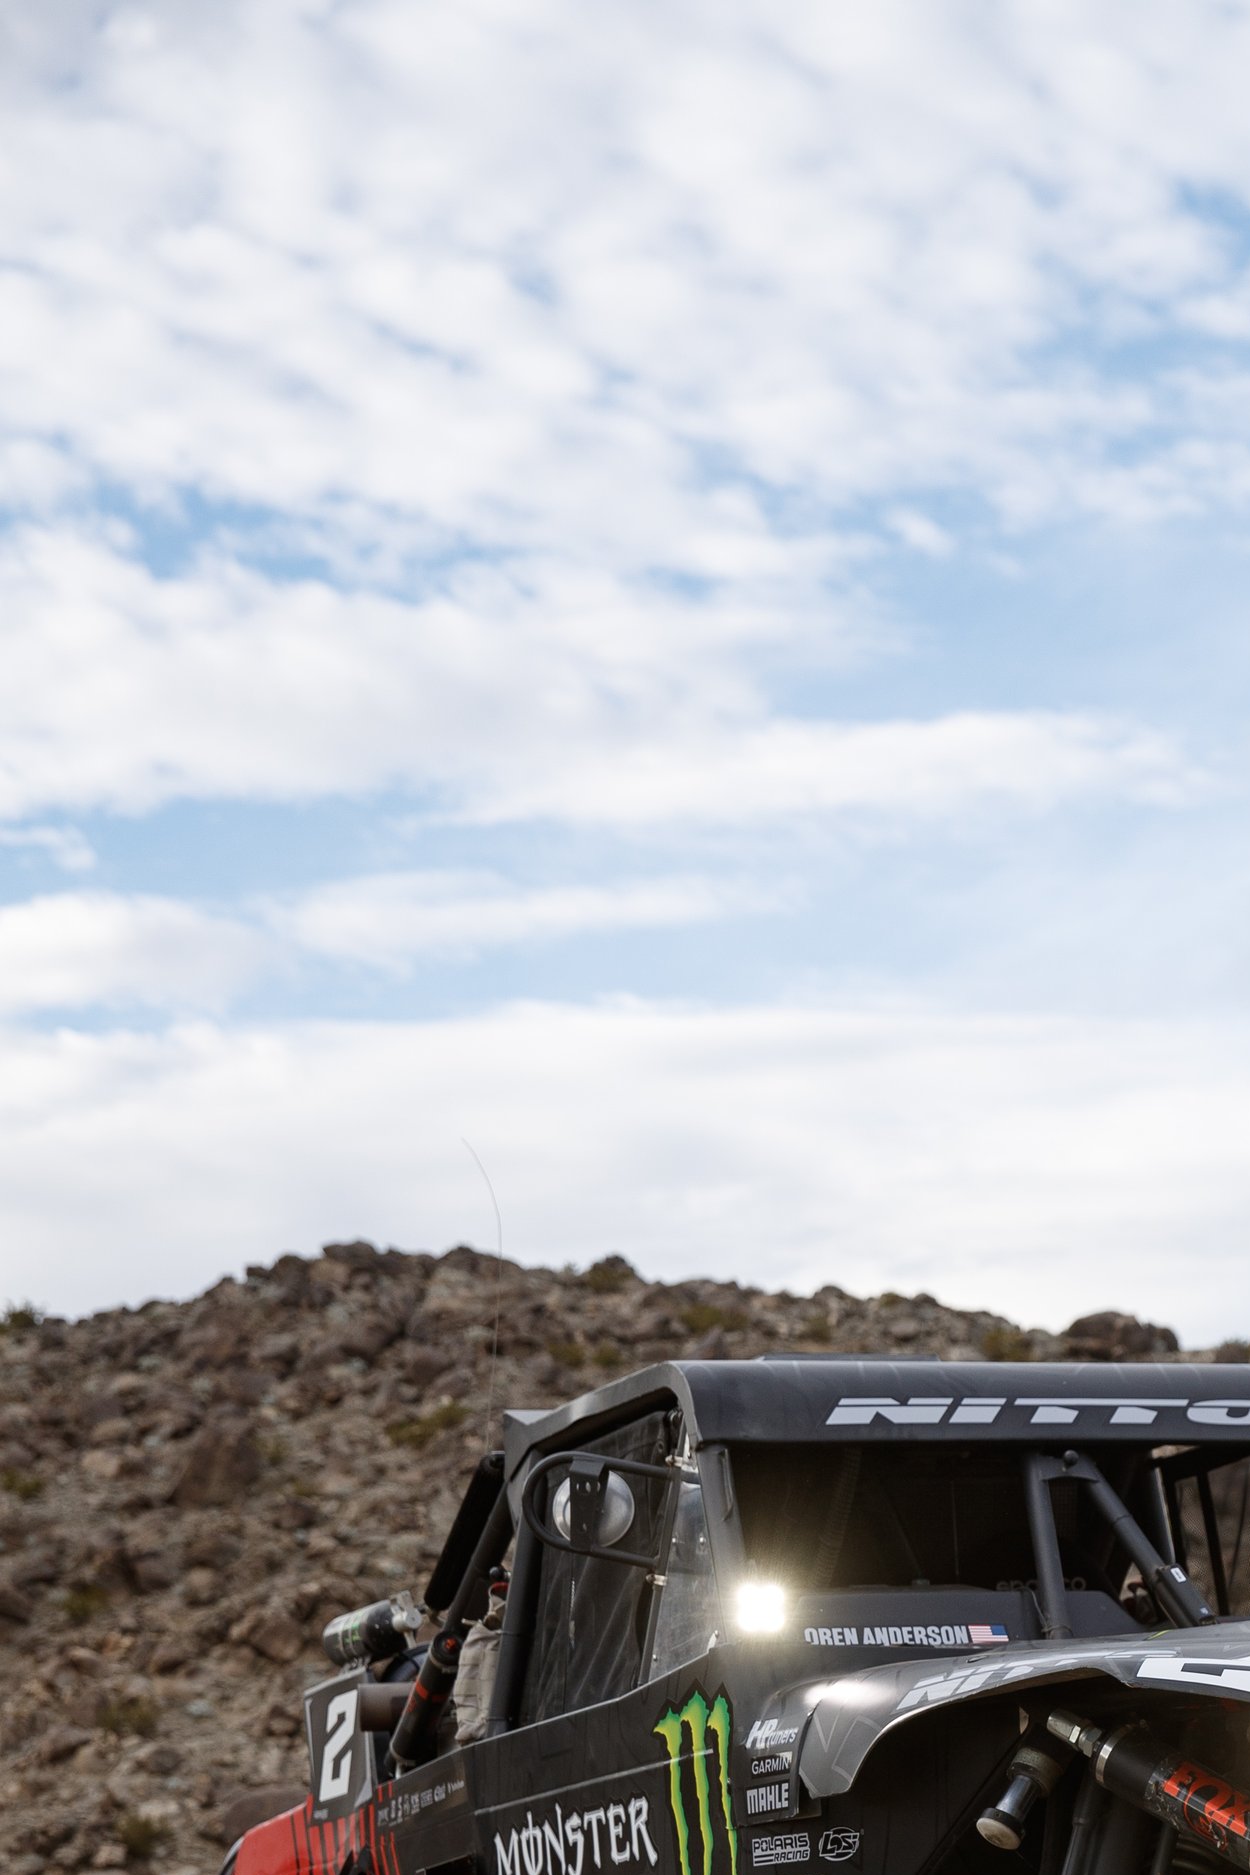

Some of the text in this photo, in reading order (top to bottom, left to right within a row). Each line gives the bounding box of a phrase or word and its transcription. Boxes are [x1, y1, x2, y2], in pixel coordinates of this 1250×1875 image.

[862, 1624, 968, 1647] ANDERSON
[319, 1688, 359, 1803] 2
[752, 1757, 791, 1775] GARMIN
[746, 1782, 789, 1815] MAHLE
[752, 1833, 810, 1853] POLARIS
[773, 1849, 810, 1863] RACING
